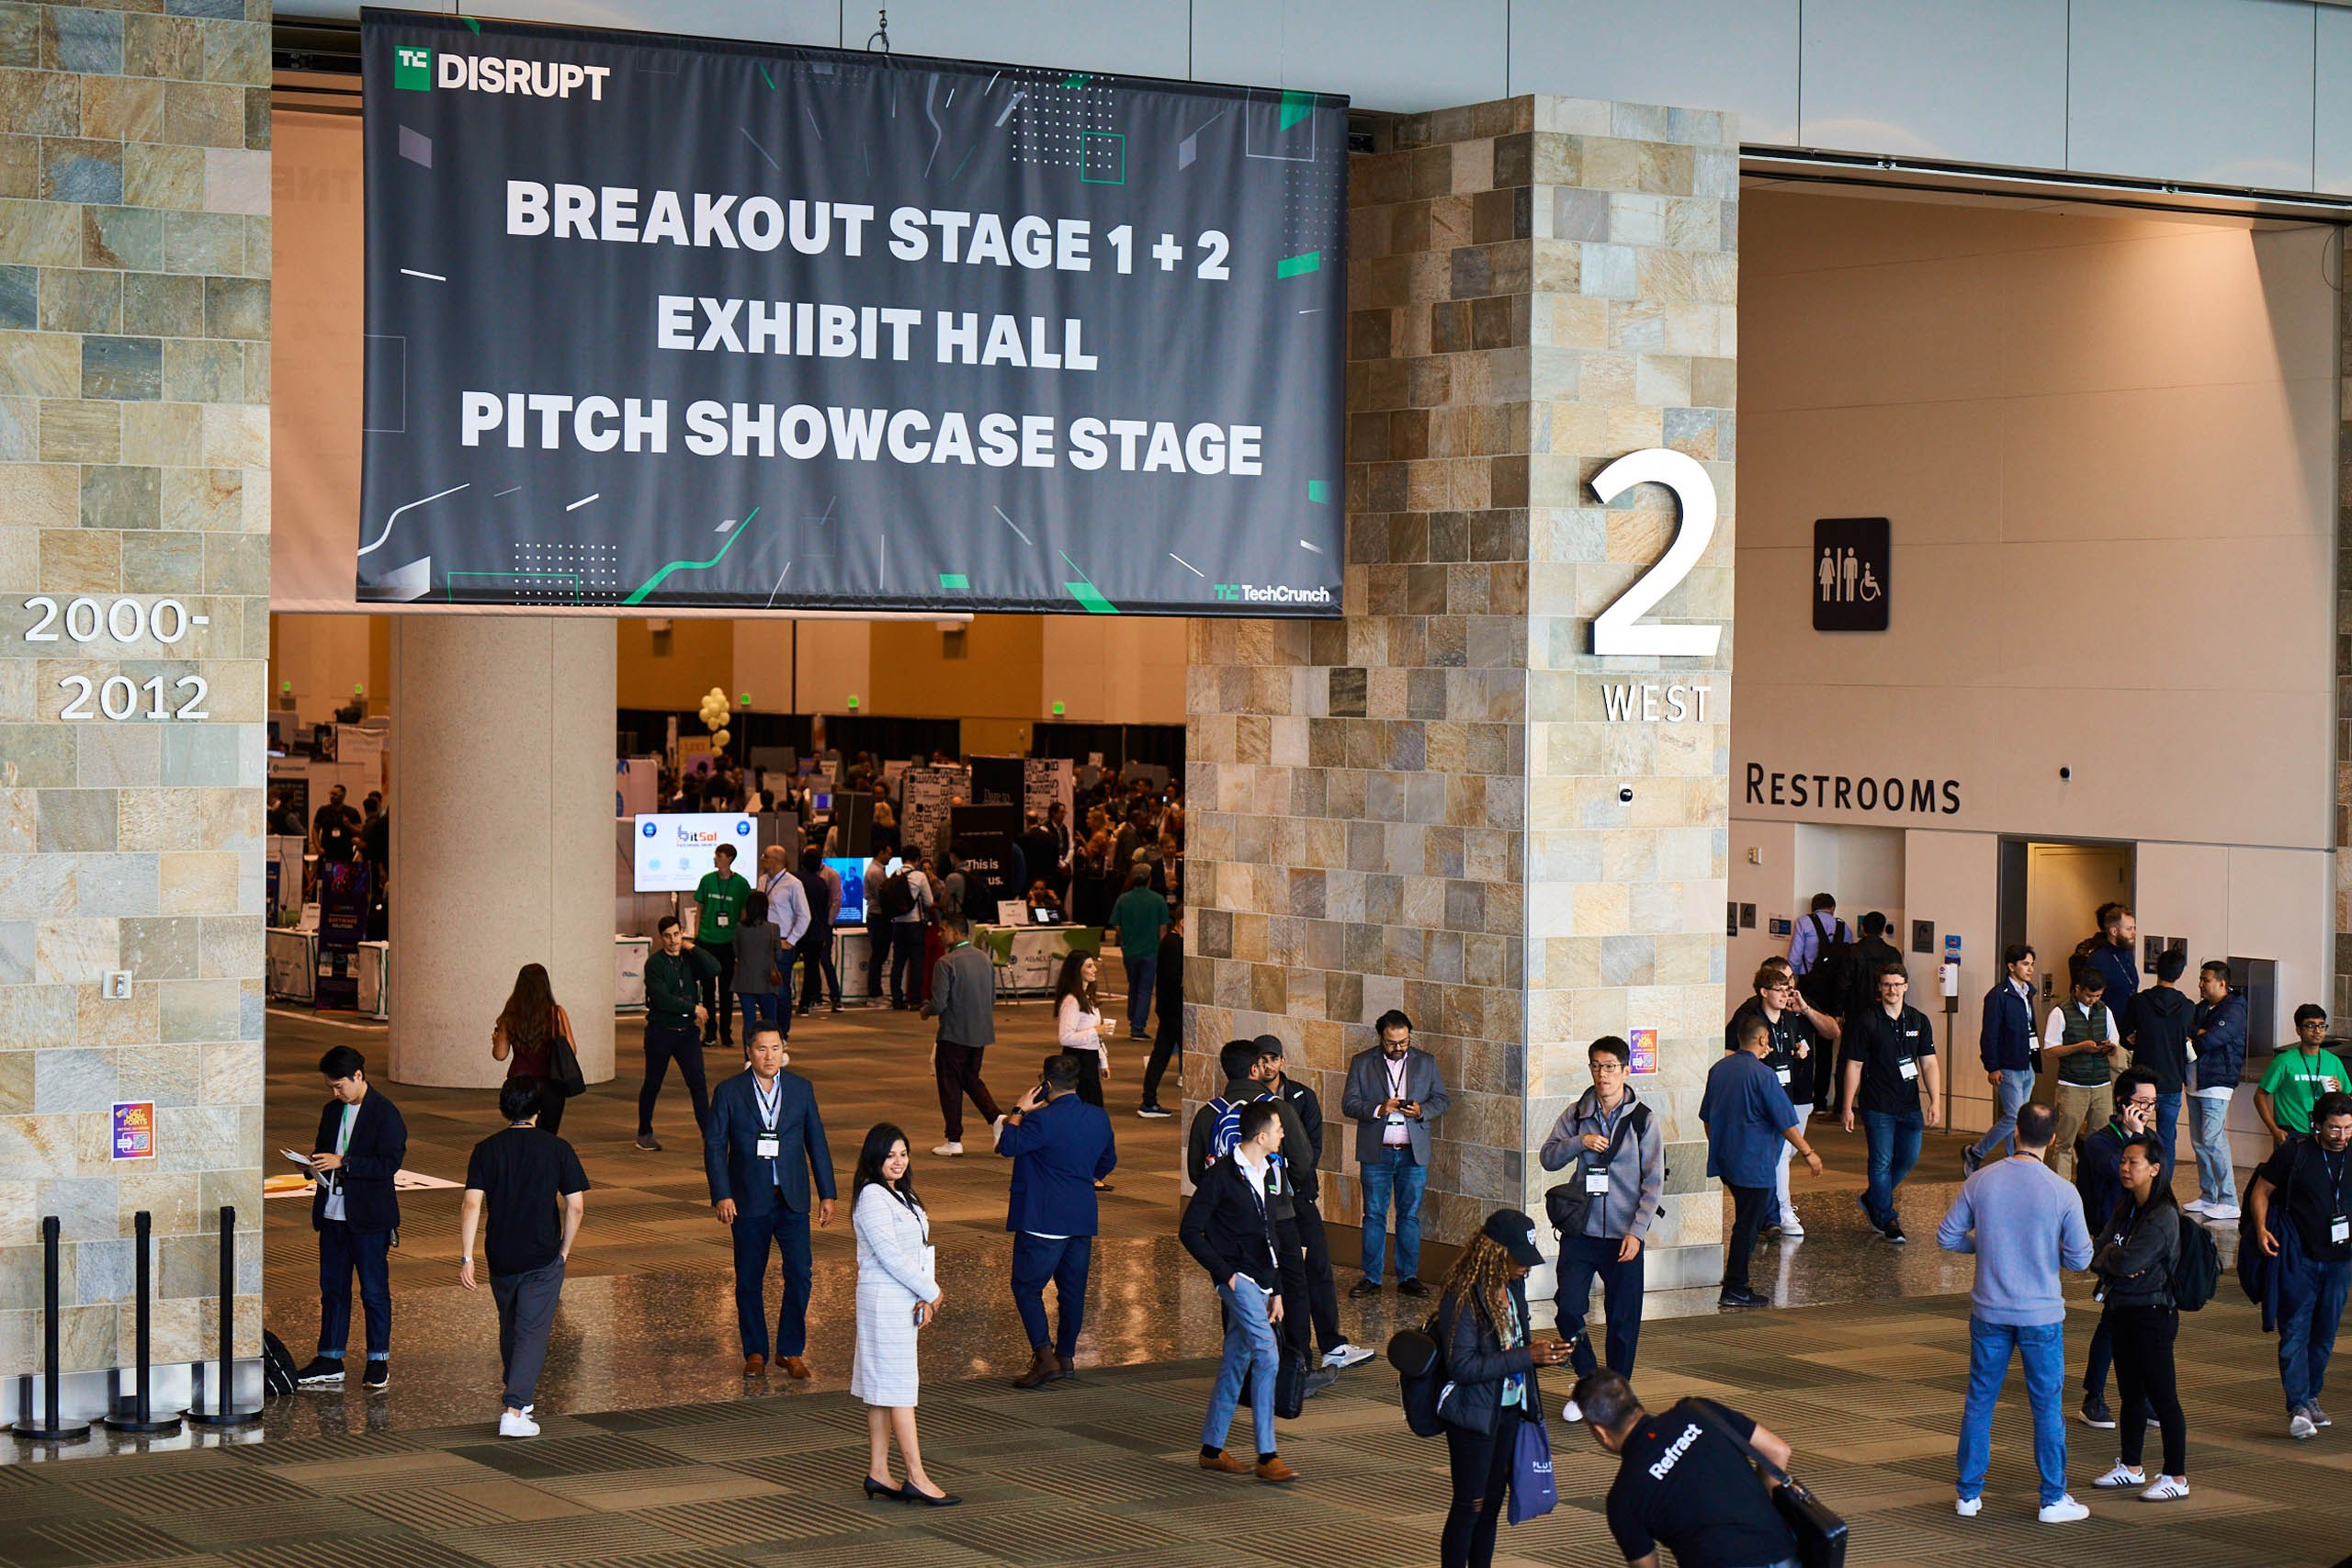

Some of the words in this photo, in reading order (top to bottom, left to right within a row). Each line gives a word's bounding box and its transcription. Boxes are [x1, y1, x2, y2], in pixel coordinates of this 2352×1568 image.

[437, 53, 611, 101] DISRUPT
[506, 179, 874, 257] BREAKOUT
[888, 206, 1091, 272] STAGE
[1106, 224, 1133, 275] 1
[1152, 233, 1182, 272] +
[1197, 230, 1230, 280] 2
[658, 294, 922, 362] EXHIBIT
[937, 310, 1098, 371] HALL
[461, 390, 668, 454] PITCH
[684, 399, 1056, 468] SHOWCASE
[1068, 417, 1263, 476] STAGE
[1590, 447, 1723, 656] 2
[1241, 584, 1330, 603] TechCrunch
[23, 596, 210, 644] 2000-
[58, 675, 210, 720] 2012
[1602, 684, 1712, 722] WEST
[1746, 762, 1961, 814] RESTROOMS
[966, 858, 989, 870] This
[989, 858, 1000, 870] is
[1648, 1424, 1703, 1481] Refract
